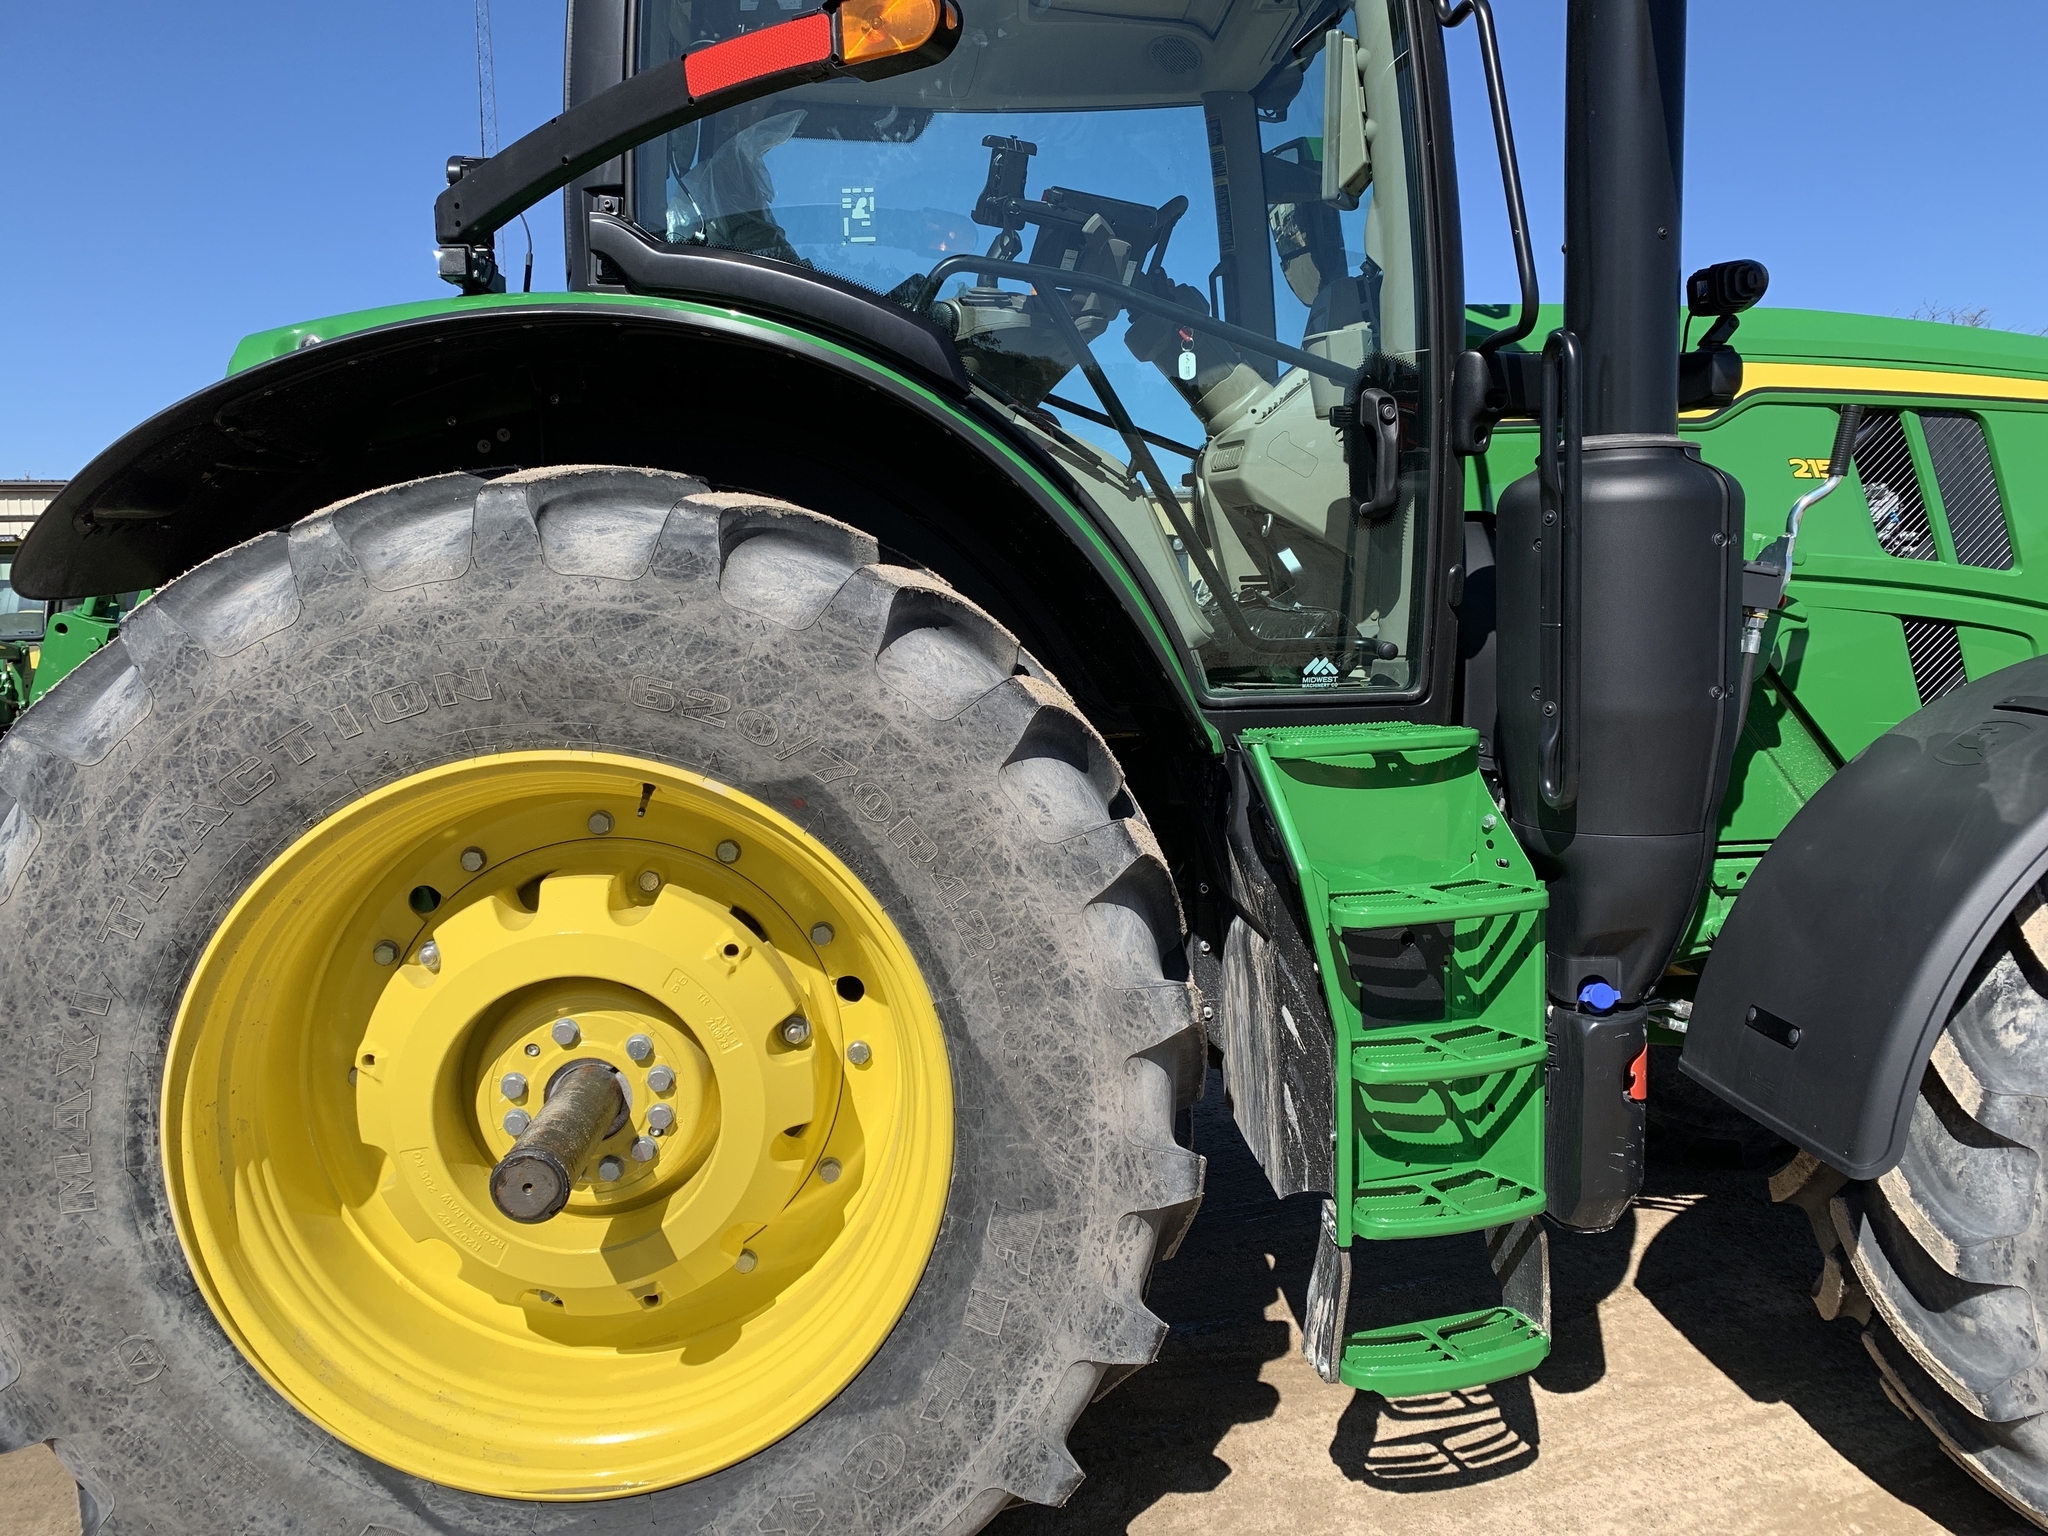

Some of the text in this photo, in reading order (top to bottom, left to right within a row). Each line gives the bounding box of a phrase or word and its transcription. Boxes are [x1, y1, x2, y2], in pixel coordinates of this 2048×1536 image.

[1302, 675, 1339, 684] MIDWEST
[628, 673, 996, 958] 620/70R42
[52, 666, 493, 1215] MAXI TRACTION
[412, 1151, 427, 1168] KG
[441, 1193, 464, 1219] RAW
